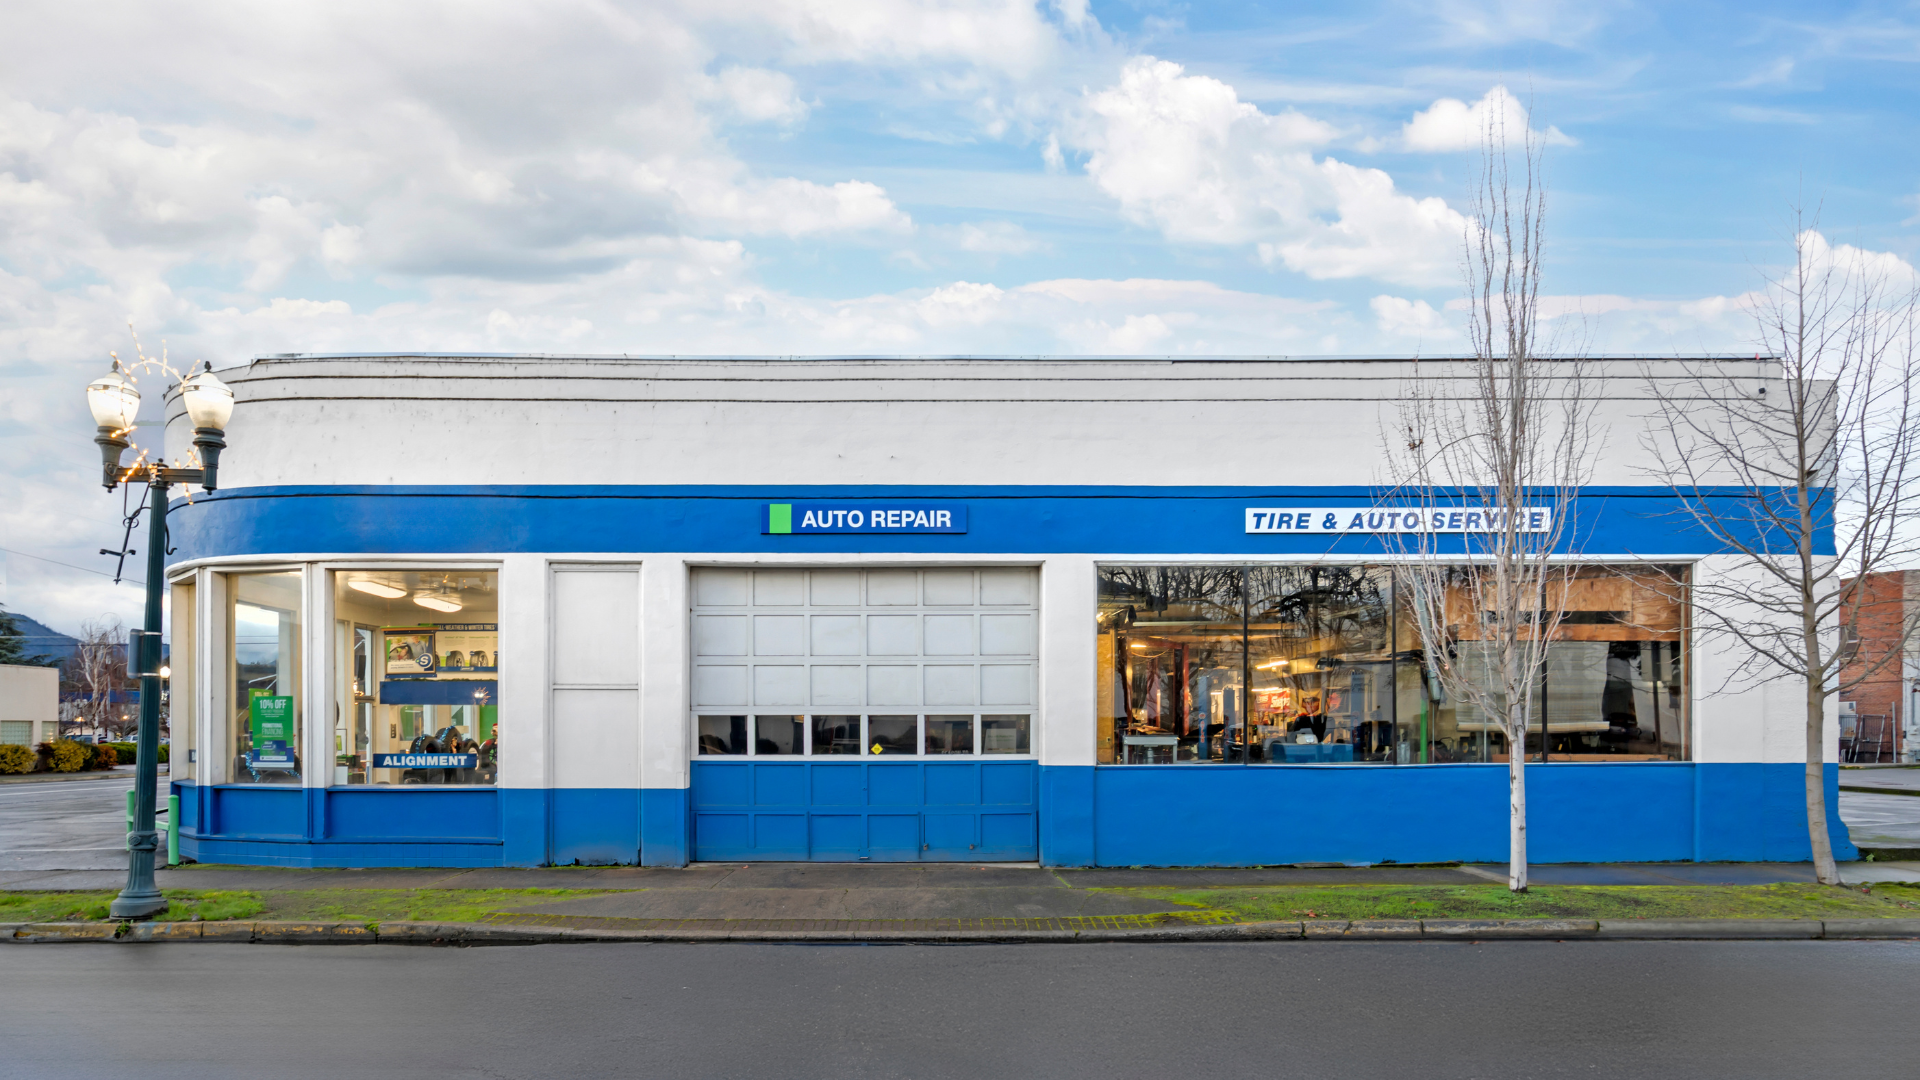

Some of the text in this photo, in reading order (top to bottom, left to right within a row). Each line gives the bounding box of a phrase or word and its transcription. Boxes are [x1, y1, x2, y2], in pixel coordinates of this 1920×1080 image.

[801, 510, 951, 528] AUTO REPAIR
[1252, 512, 1312, 530] TIRE
[1322, 512, 1338, 530] &
[1350, 512, 1419, 530] AUTO
[259, 699, 287, 709] 10% OFF
[383, 755, 468, 766] ALIGNMENT
